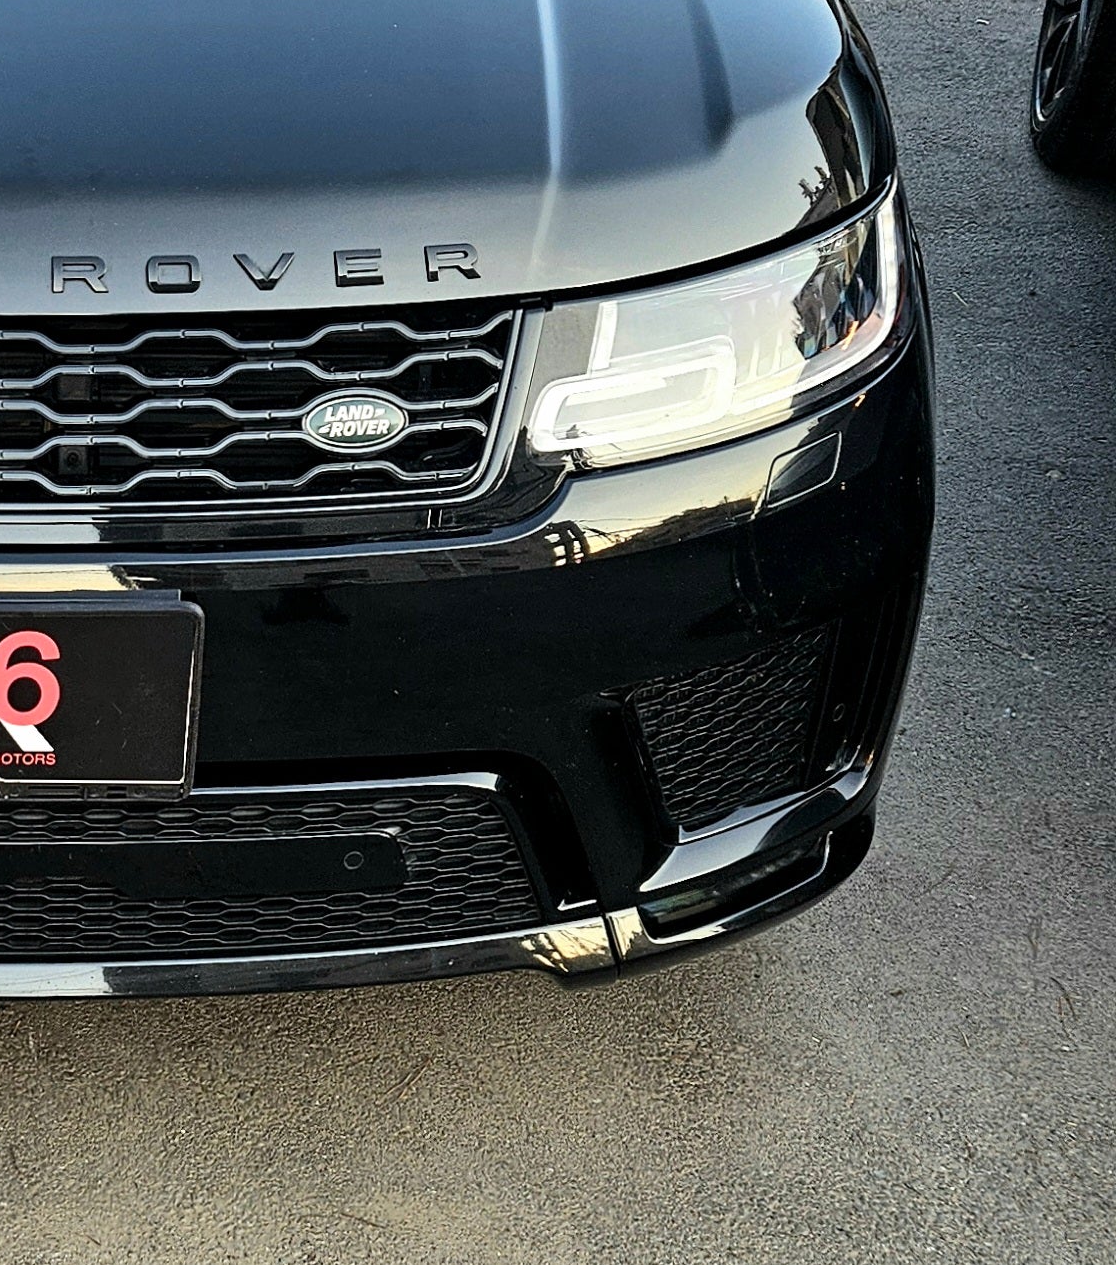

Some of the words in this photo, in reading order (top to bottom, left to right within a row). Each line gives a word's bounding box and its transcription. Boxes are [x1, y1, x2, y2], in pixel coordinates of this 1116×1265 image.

[51, 243, 482, 294] ROVER
[324, 404, 375, 423] LAND
[329, 418, 392, 438] ROVER
